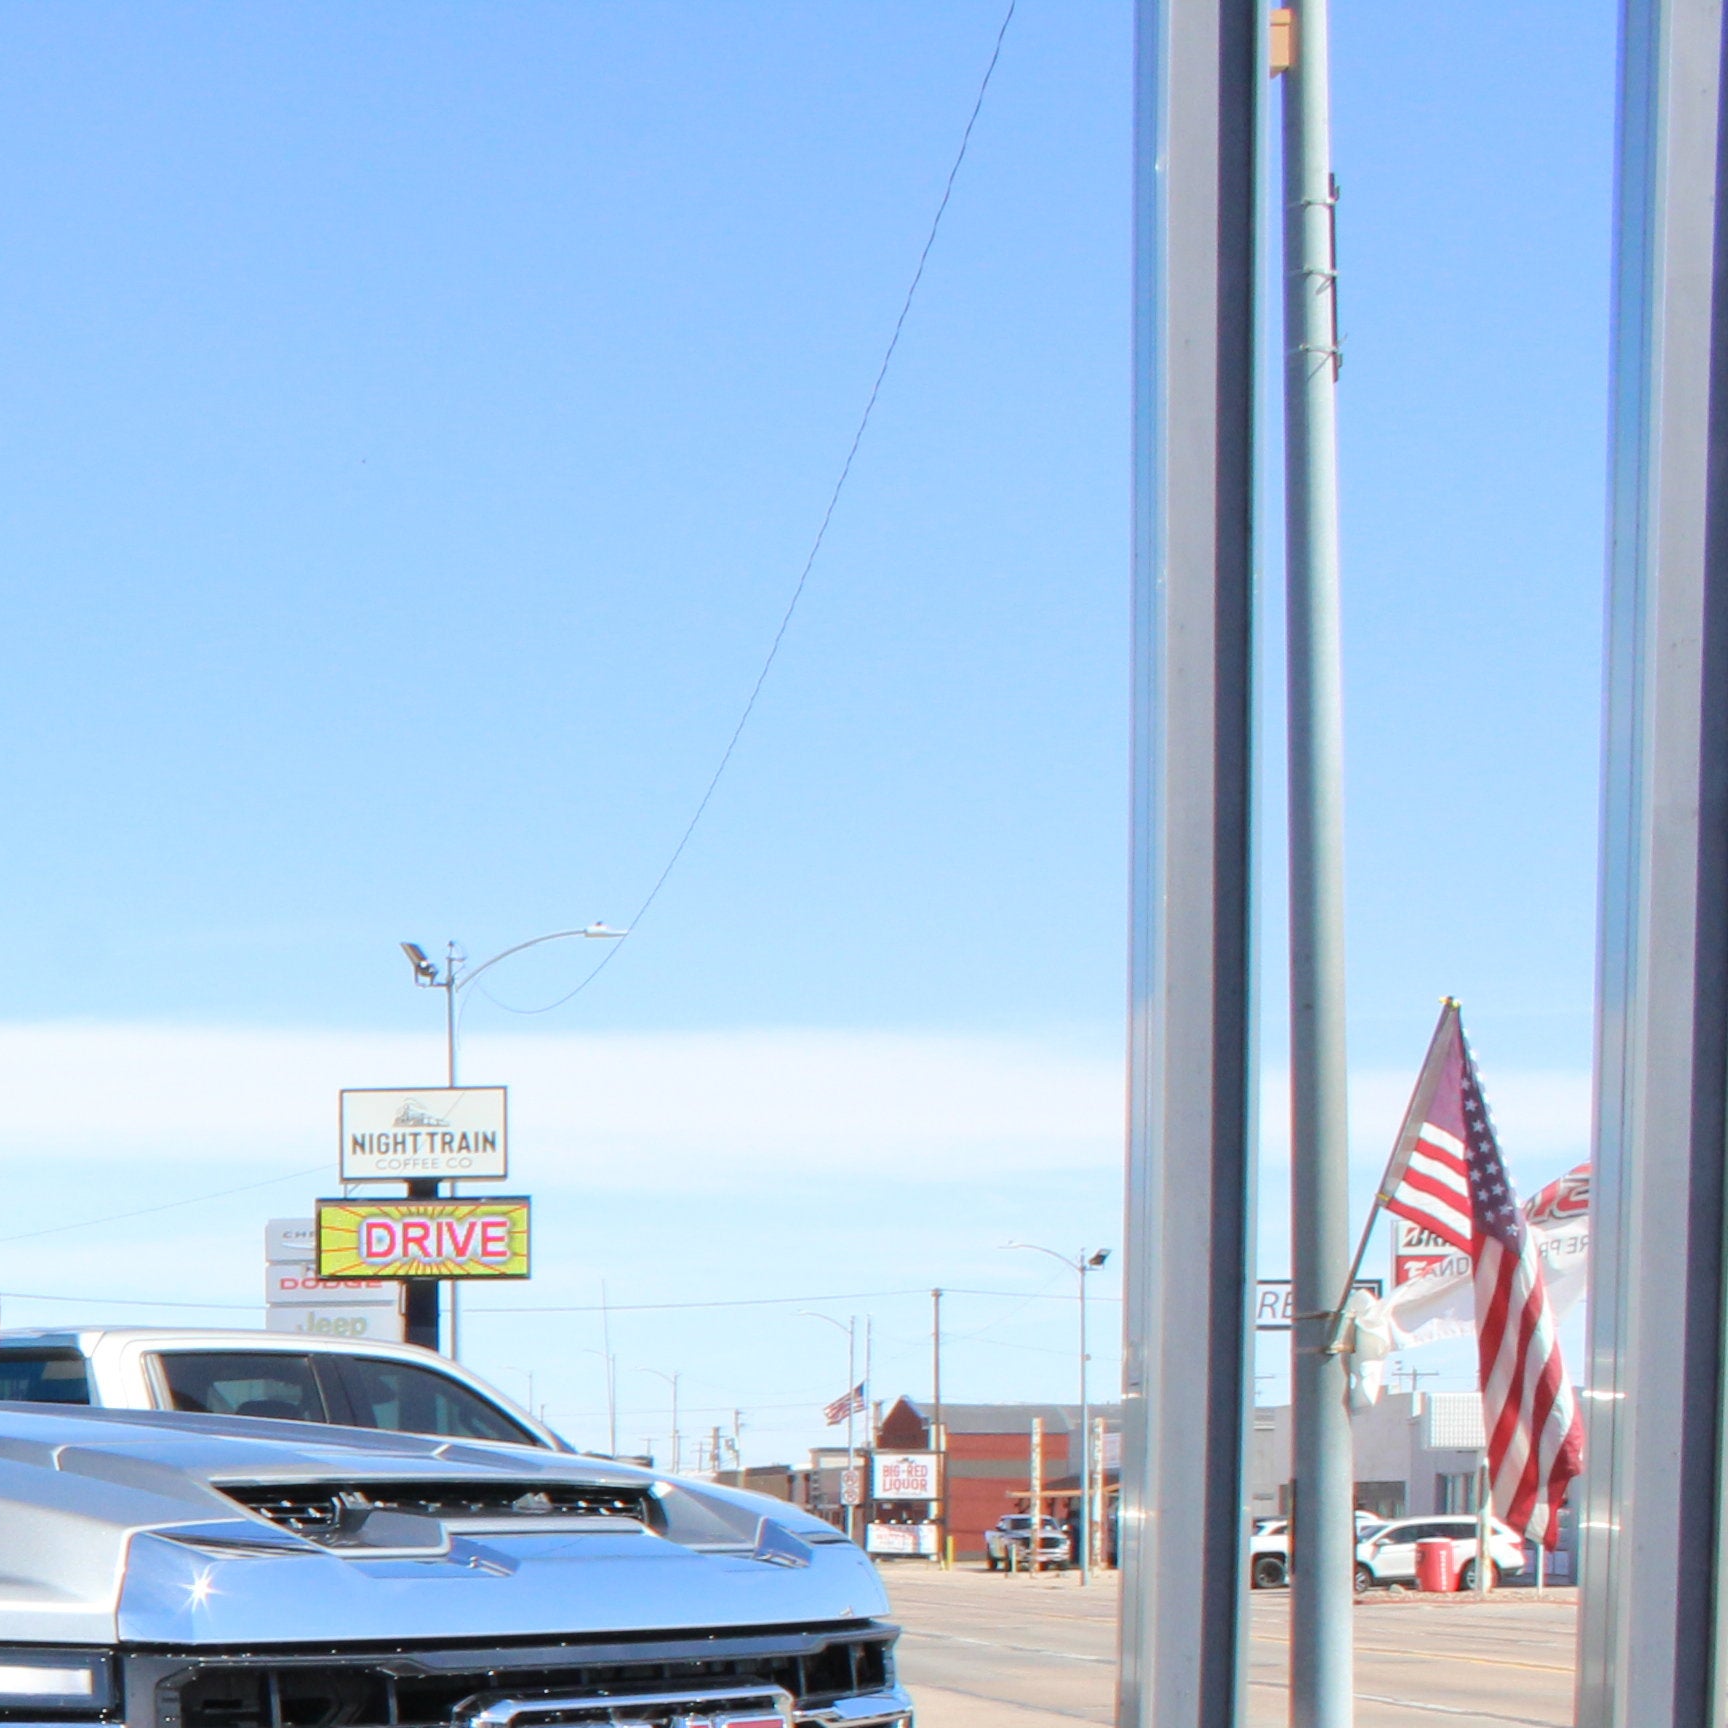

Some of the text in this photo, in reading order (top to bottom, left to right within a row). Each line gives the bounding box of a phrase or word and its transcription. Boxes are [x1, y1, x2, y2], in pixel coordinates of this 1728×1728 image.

[351, 1131, 497, 1156] NIGHT TRAIN
[375, 1157, 473, 1170] COFFEE CO
[364, 1220, 511, 1258] DRIVE
[280, 1278, 383, 1290] DODGE
[295, 1311, 367, 1336] Jeep
[882, 1479, 928, 1492] LIQUOR
